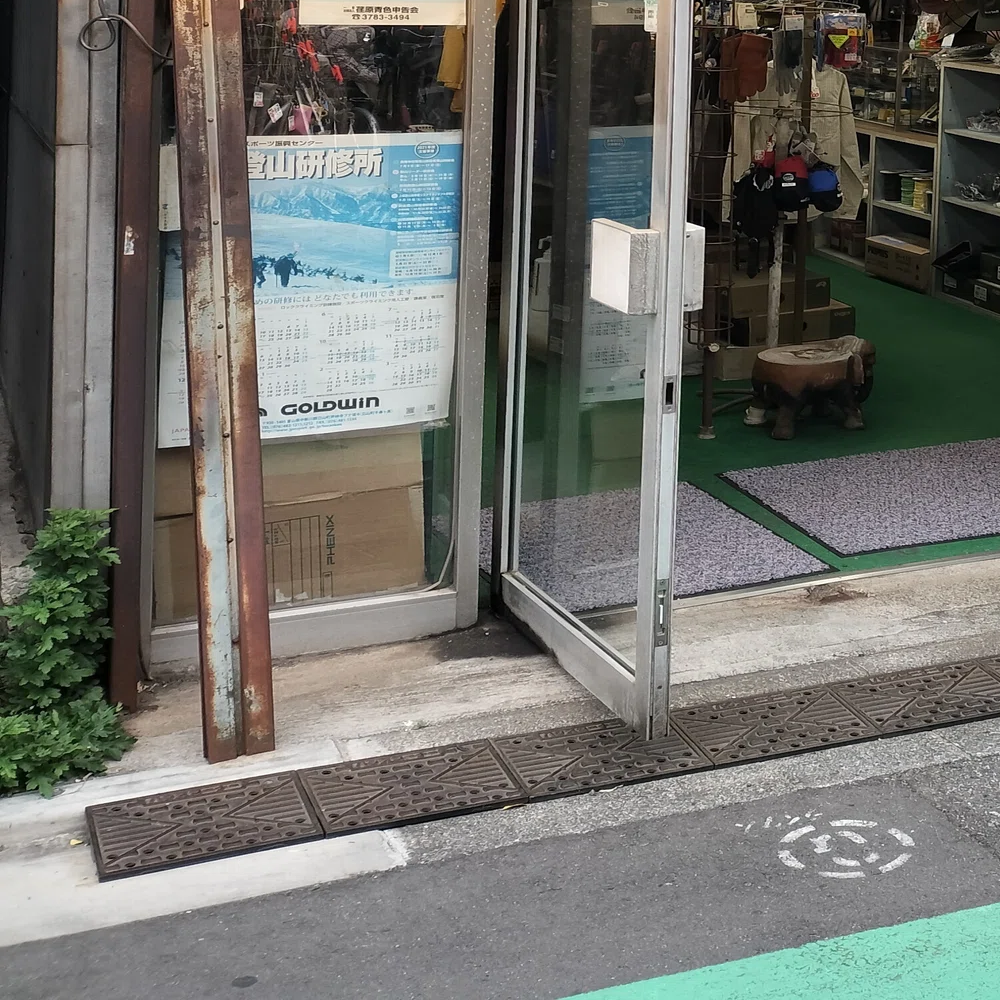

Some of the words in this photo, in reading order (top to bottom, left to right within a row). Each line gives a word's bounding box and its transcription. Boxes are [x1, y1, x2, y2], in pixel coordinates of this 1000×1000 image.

[361, 14, 410, 22] 3783-3494
[248, 148, 384, 180] 登山研修所
[326, 514, 335, 565] PHENIX
